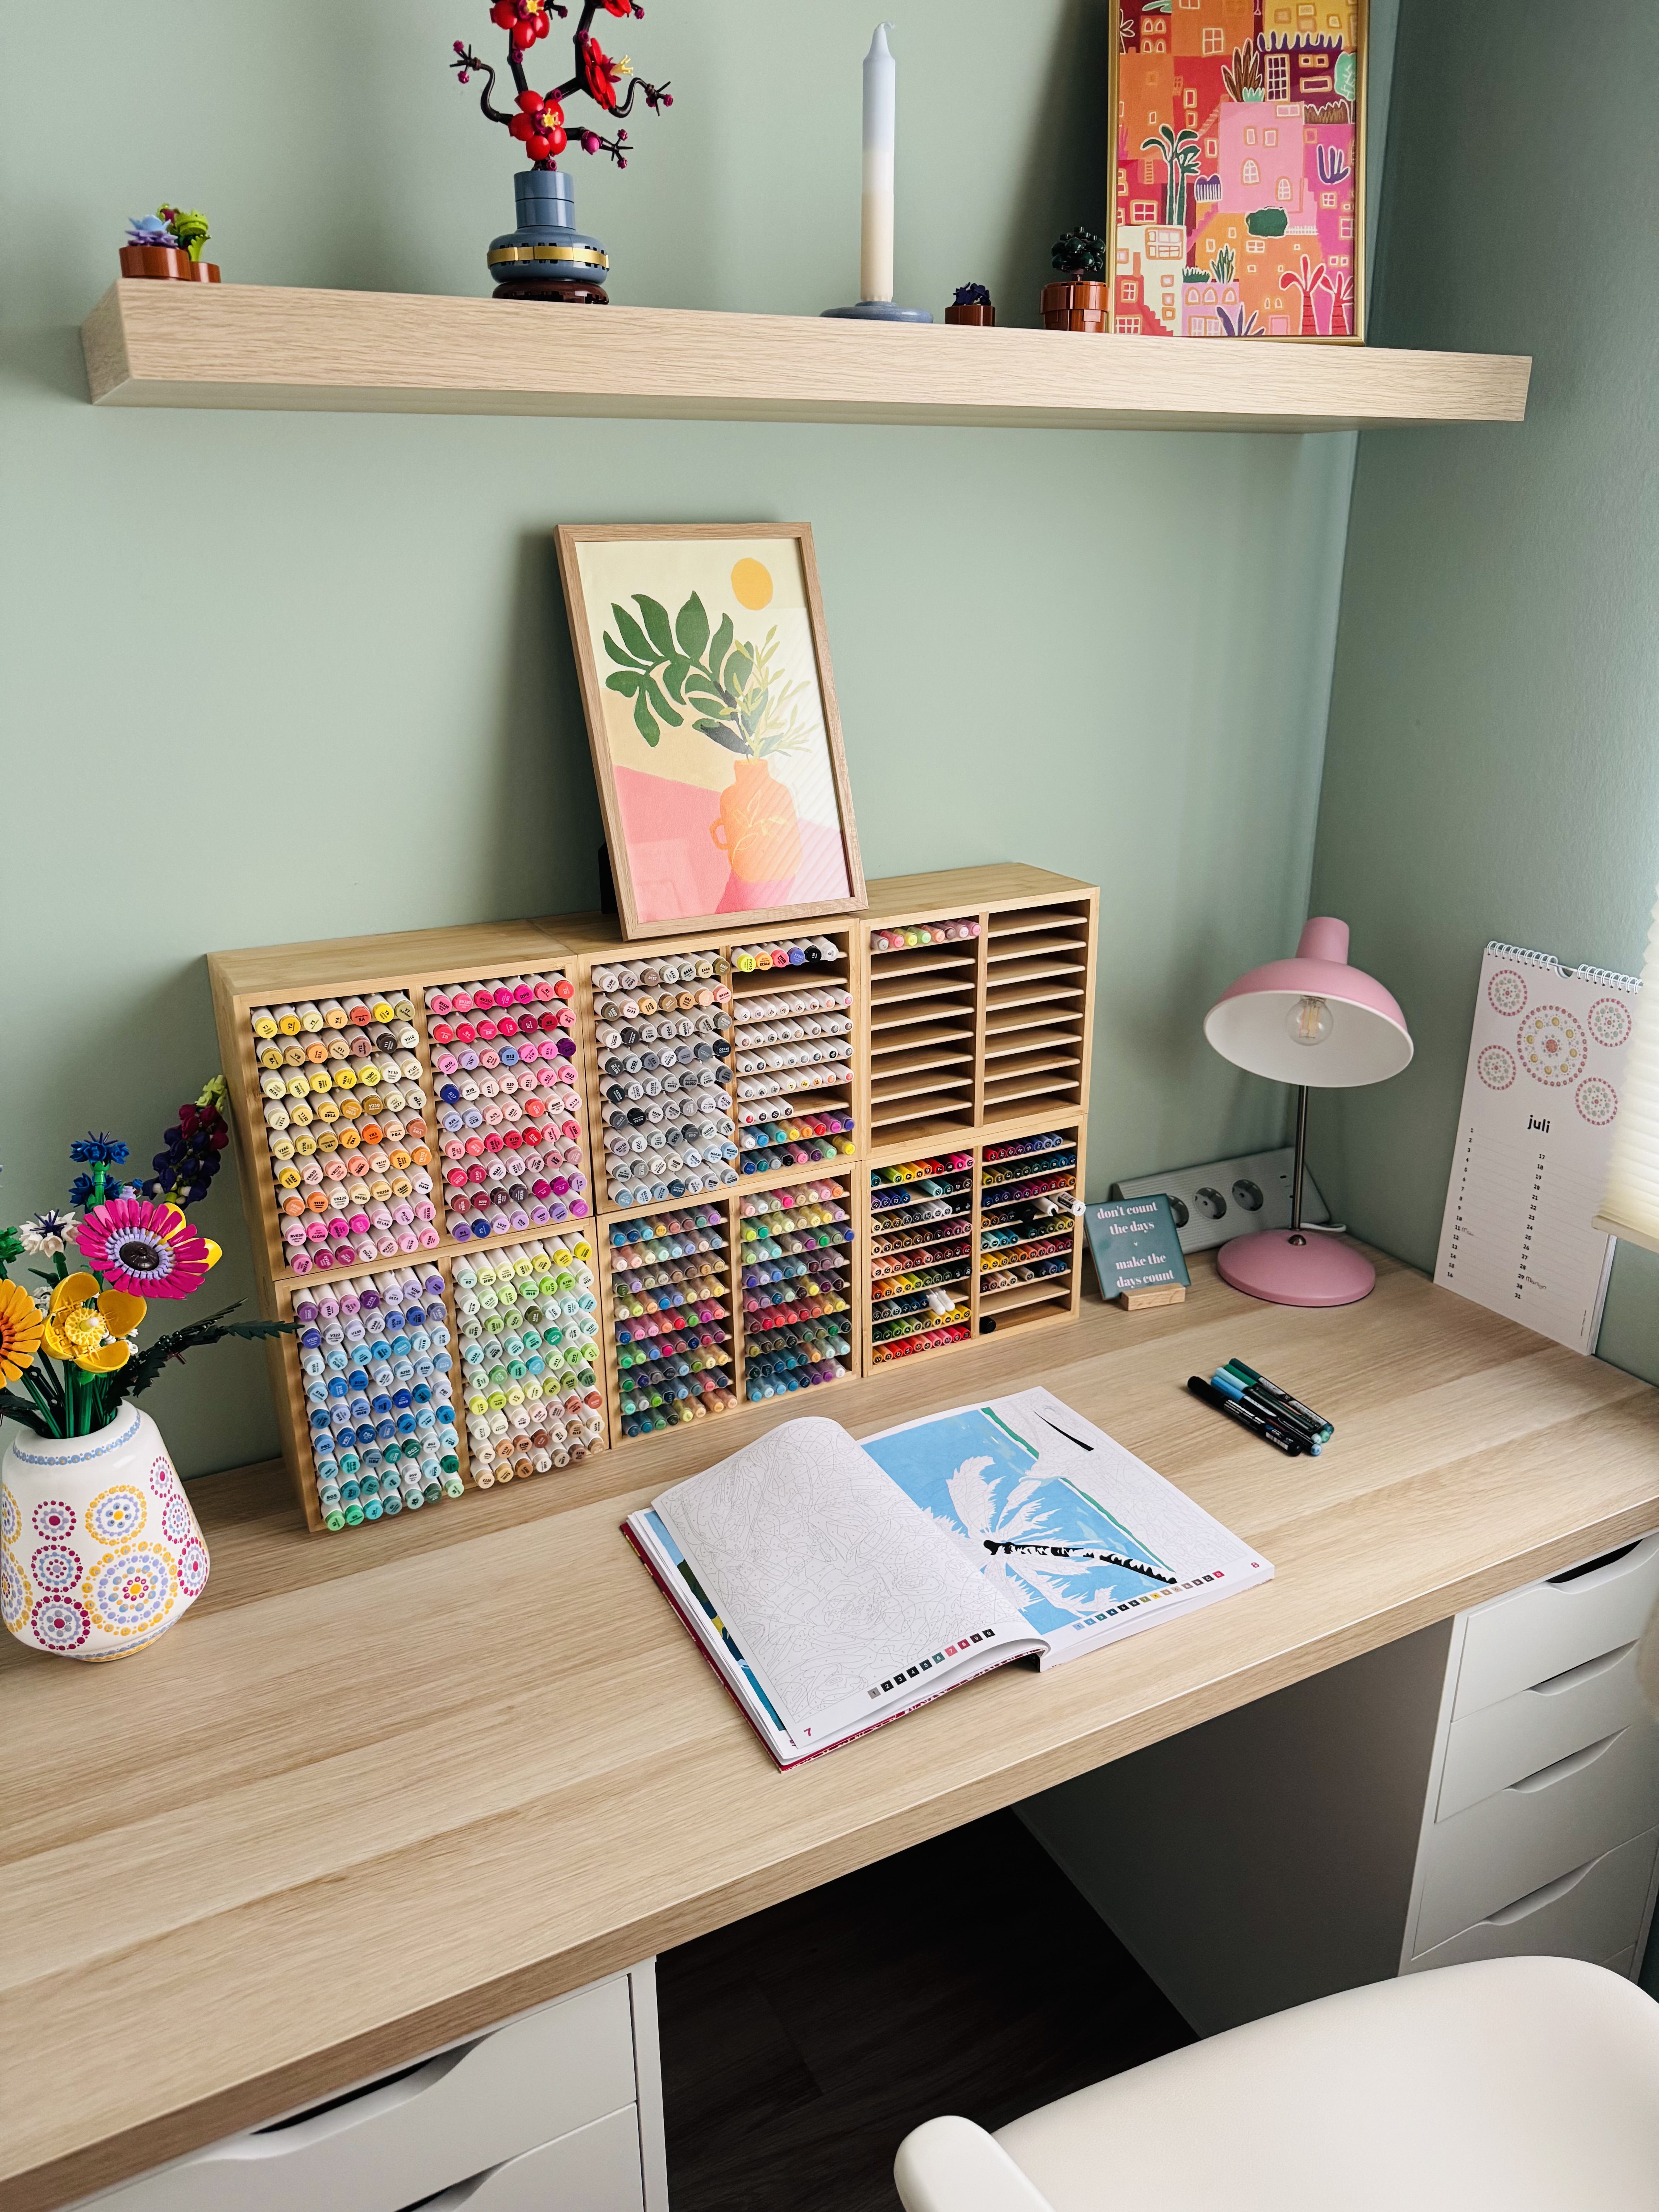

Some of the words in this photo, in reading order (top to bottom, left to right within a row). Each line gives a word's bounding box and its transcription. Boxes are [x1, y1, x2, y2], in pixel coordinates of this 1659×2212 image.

[1527, 1115, 1550, 1133] juli
[1097, 1206, 1125, 1219] don't
[1127, 1202, 1158, 1214] count
[1109, 1224, 1128, 1235] the
[1130, 1221, 1154, 1233] days
[1116, 1257, 1146, 1269] make
[1147, 1253, 1166, 1264] the
[1117, 1277, 1141, 1288] days
[1143, 1270, 1174, 1283] count
[804, 1728, 811, 1736] 7
